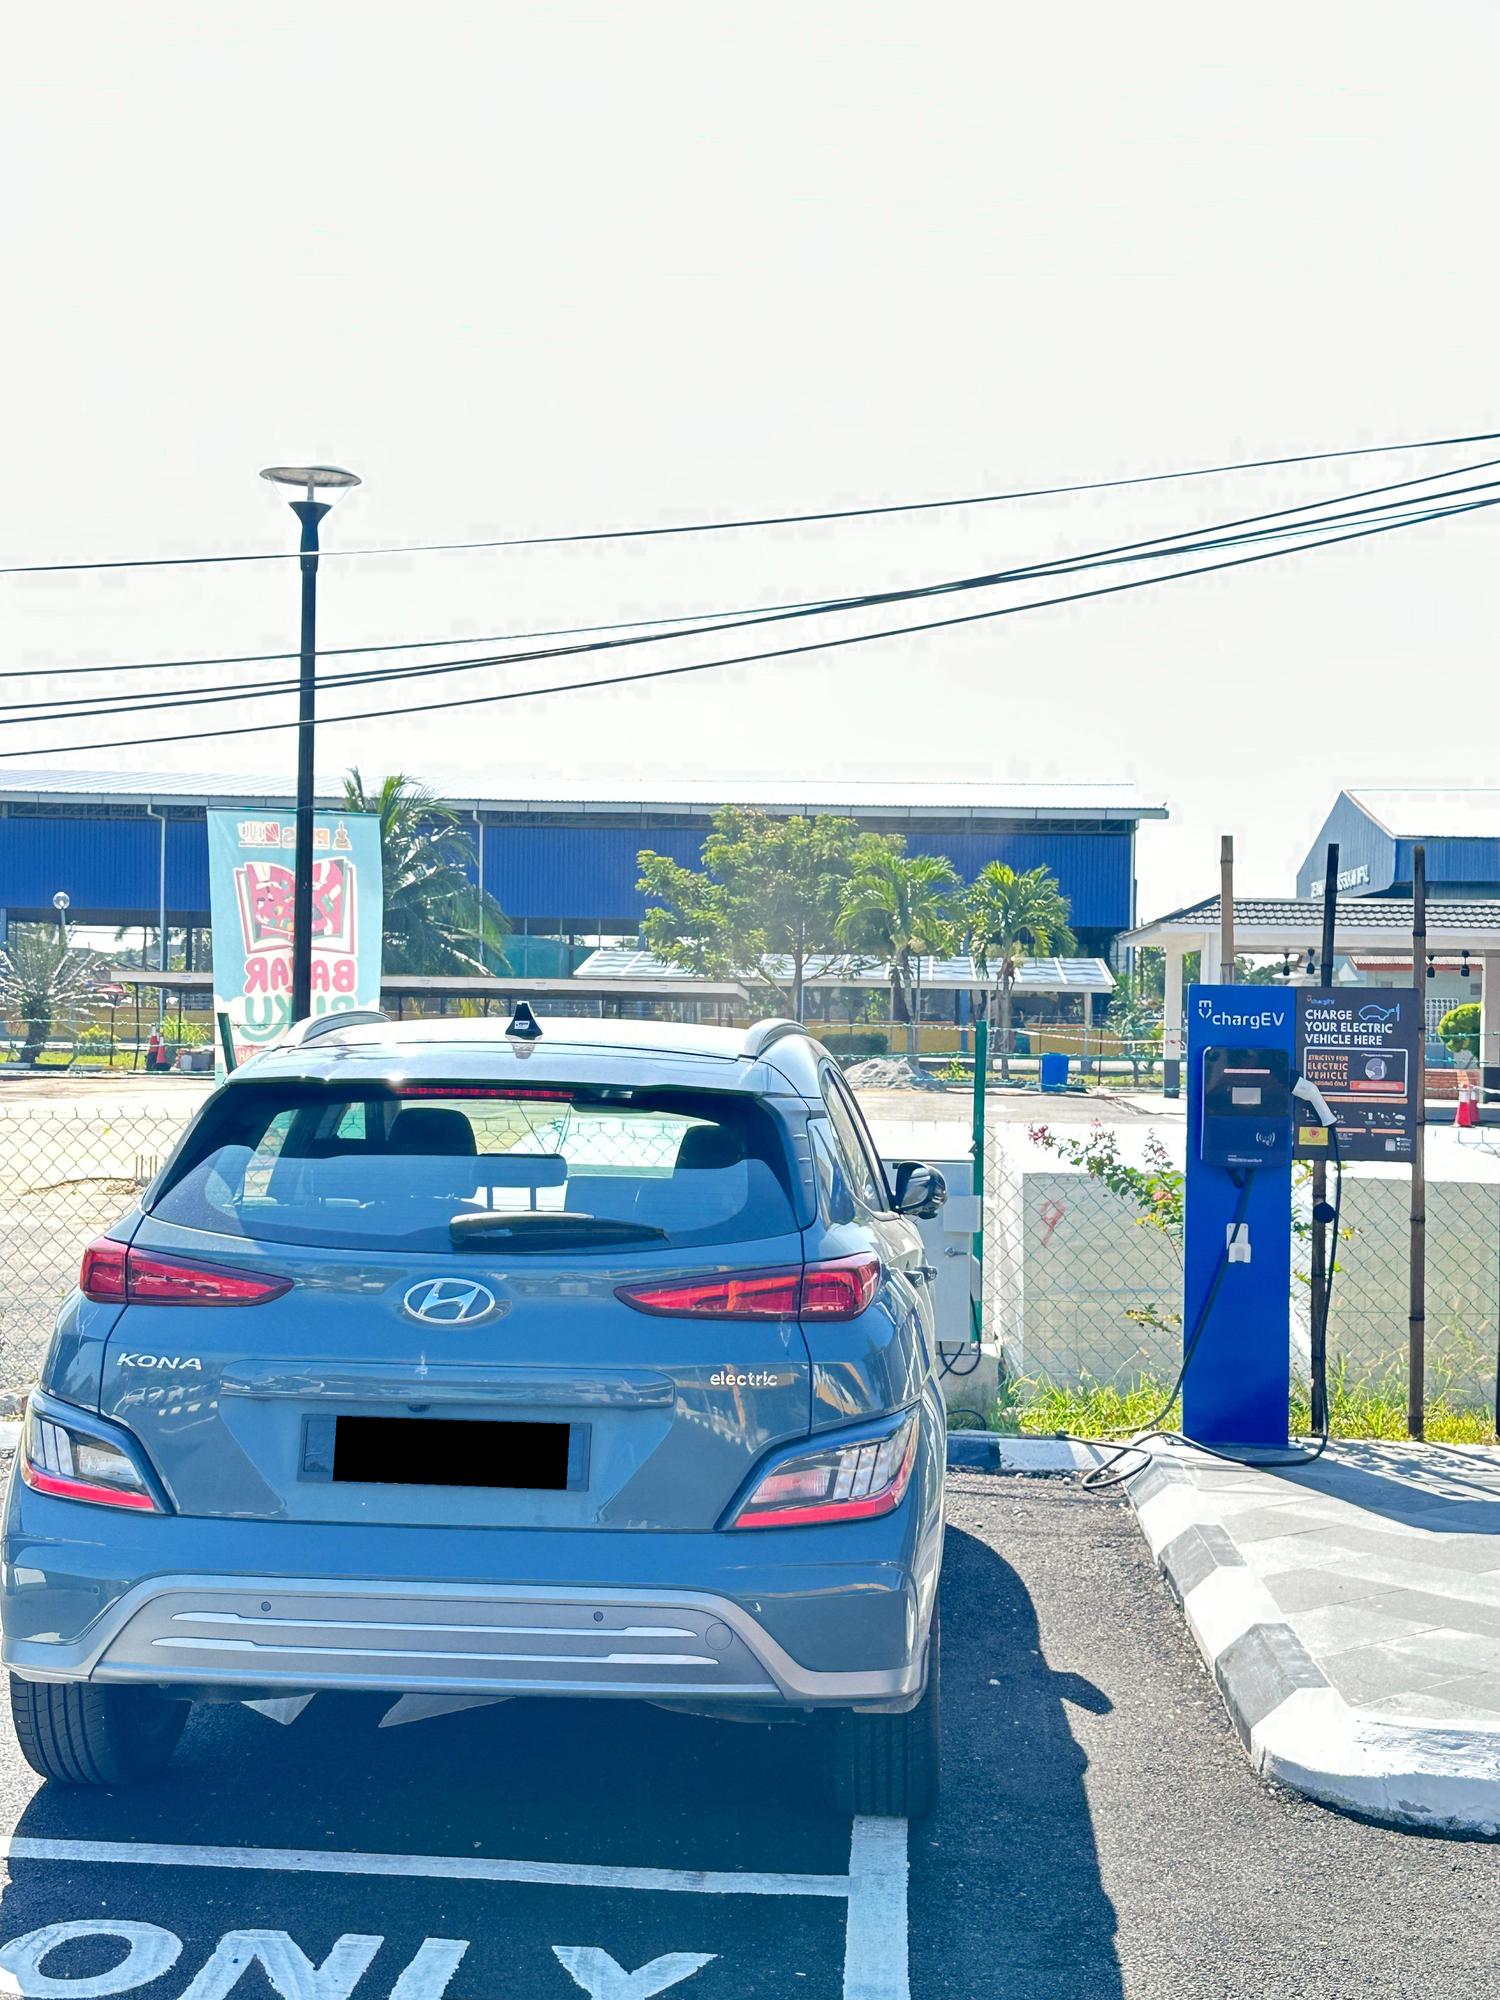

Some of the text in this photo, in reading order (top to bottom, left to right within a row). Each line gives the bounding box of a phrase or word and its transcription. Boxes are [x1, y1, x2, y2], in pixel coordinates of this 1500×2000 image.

[1212, 1012, 1285, 1029] chargEV
[1305, 1009, 1352, 1020] CHARGE
[1305, 1021, 1393, 1033] YOUR ELECTRIC
[1305, 1033, 1383, 1045] VEHICLE HERE
[1307, 1062, 1349, 1071] ELECTRIC
[1307, 1071, 1348, 1080] VEHICLE
[116, 1352, 203, 1371] KONA
[709, 1370, 778, 1387] electric
